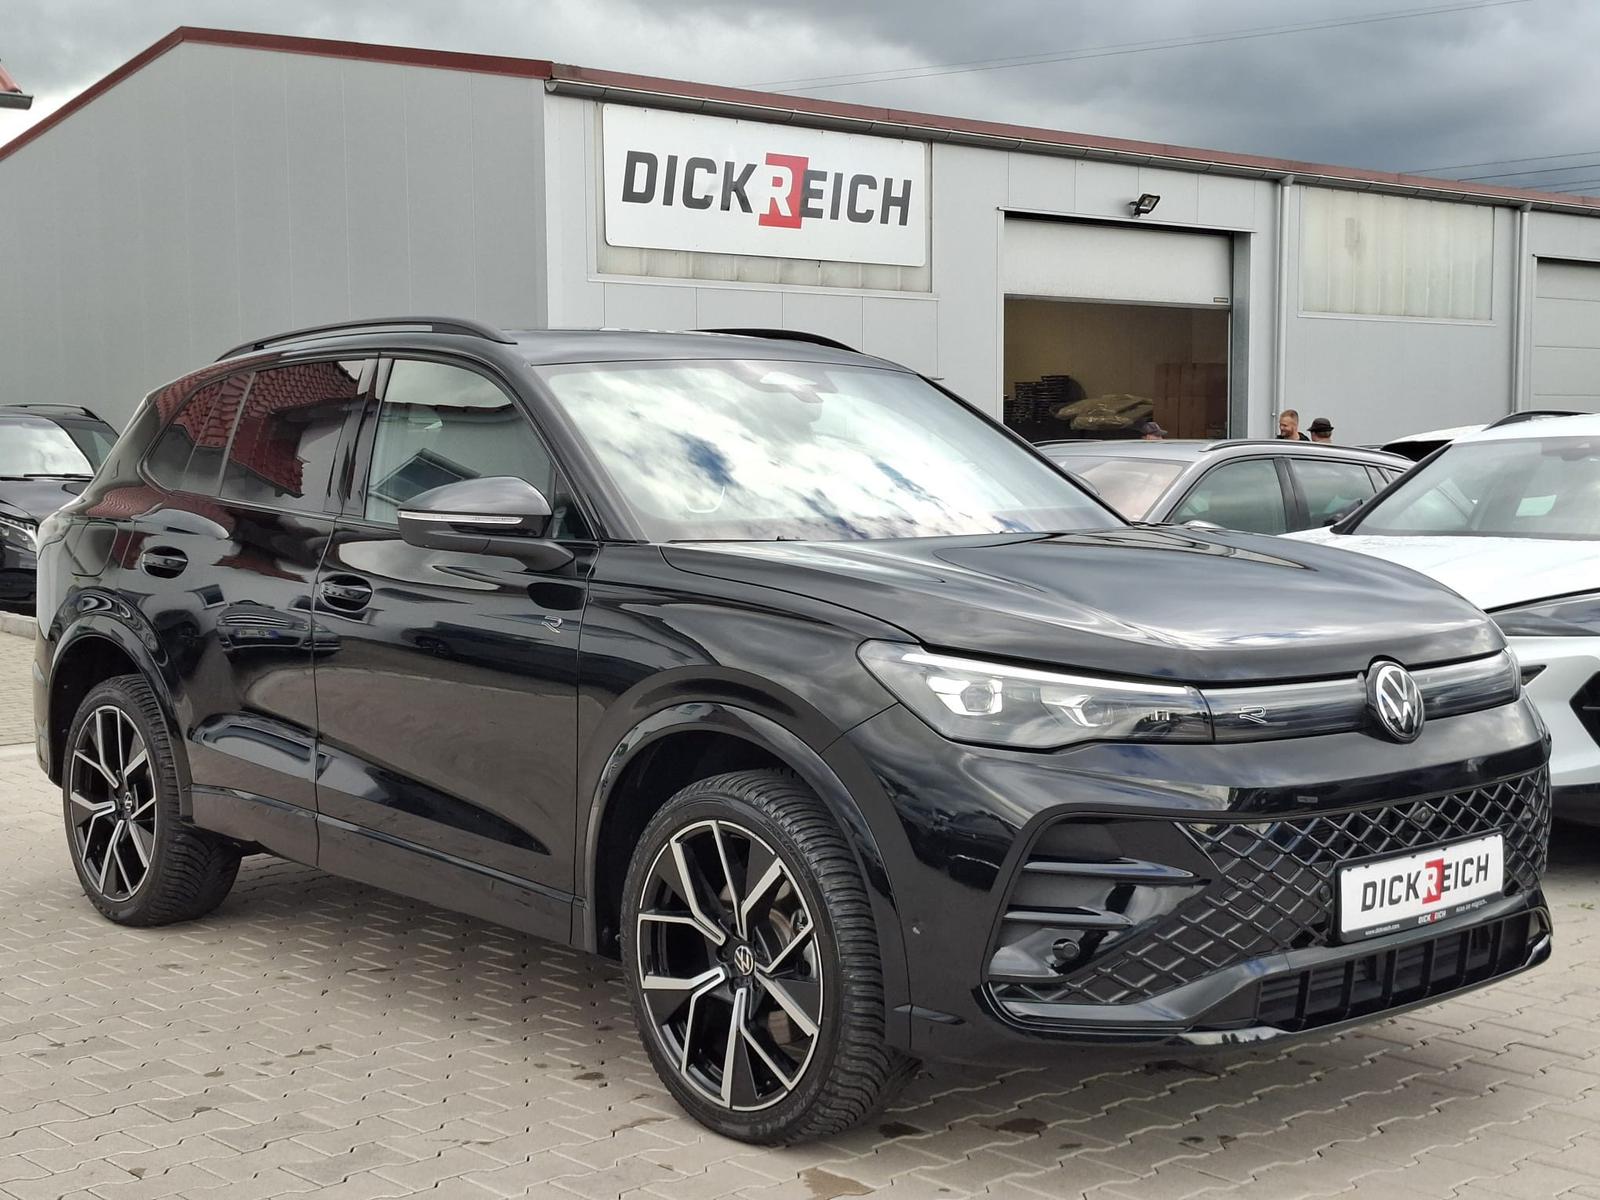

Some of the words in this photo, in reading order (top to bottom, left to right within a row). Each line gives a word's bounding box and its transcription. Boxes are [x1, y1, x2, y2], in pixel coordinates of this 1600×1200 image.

[622, 150, 912, 229] DICKREICH
[1376, 661, 1424, 740] VW
[1361, 854, 1489, 911] DICKREICH
